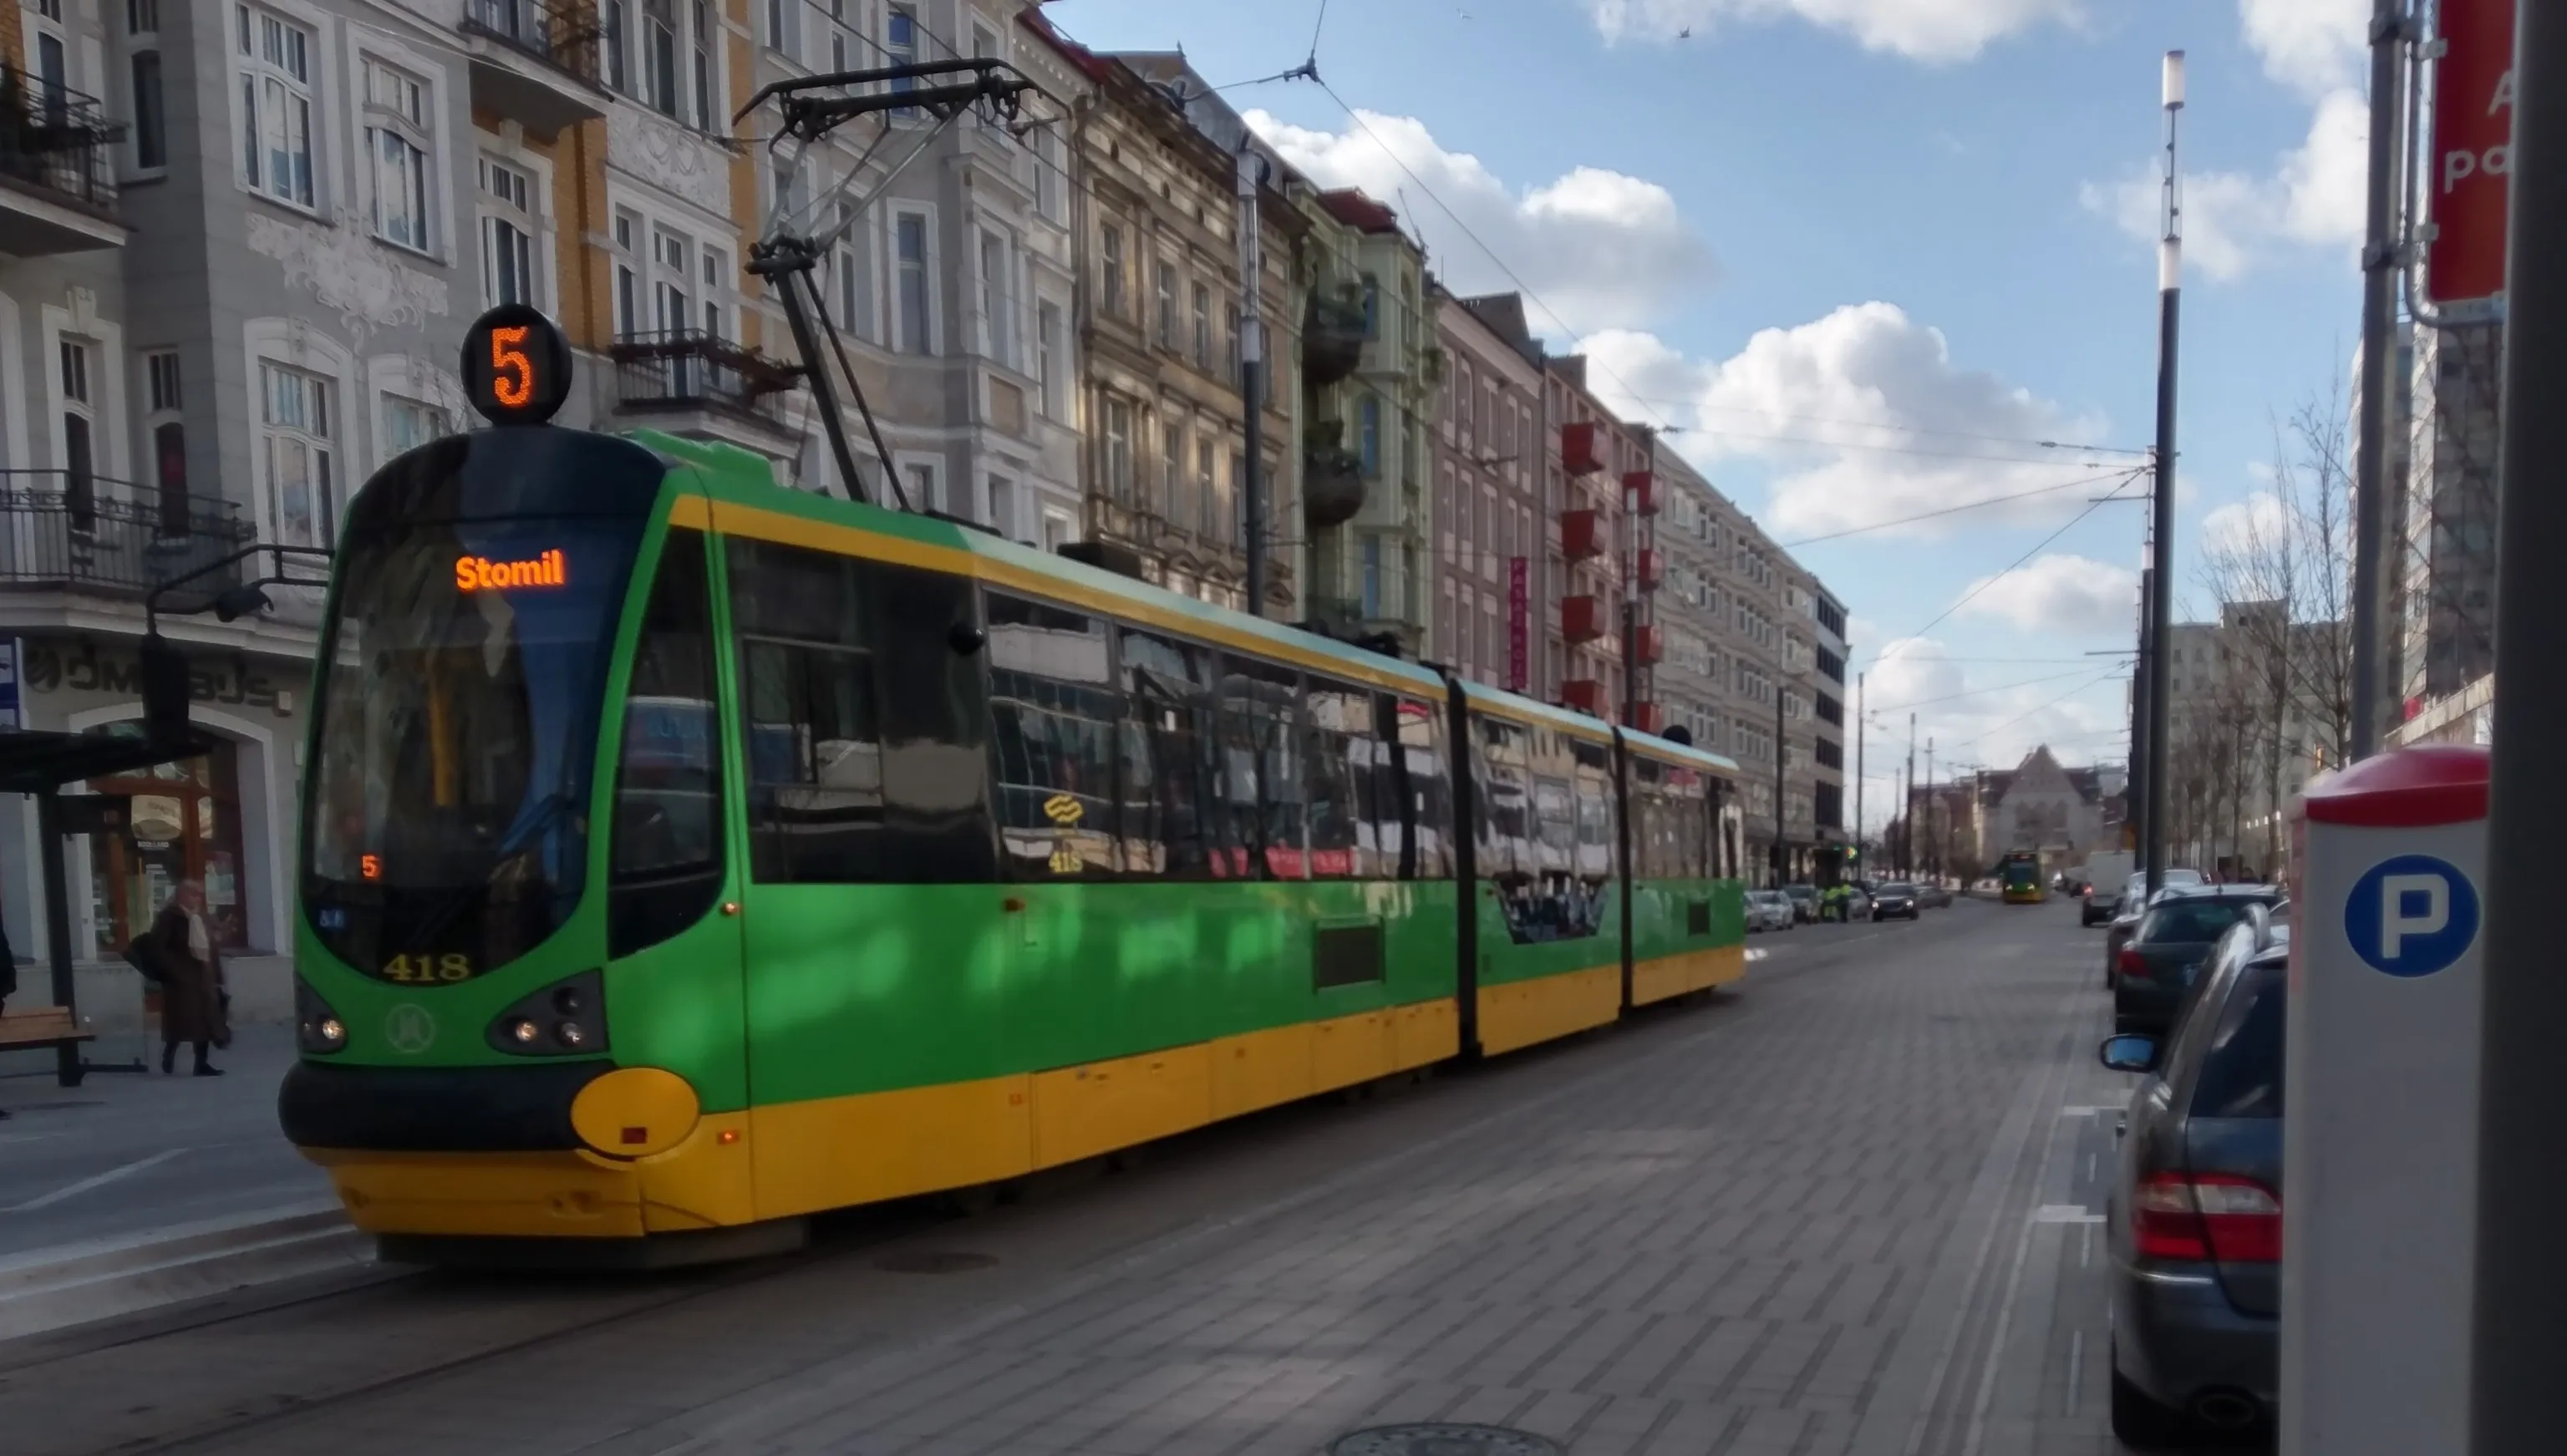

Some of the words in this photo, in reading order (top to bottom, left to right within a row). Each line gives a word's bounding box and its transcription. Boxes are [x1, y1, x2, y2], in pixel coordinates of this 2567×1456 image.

[492, 325, 531, 404] 5
[455, 549, 564, 591] Stomil
[67, 657, 279, 707] OMBUS
[361, 854, 383, 879] 5
[1049, 850, 1084, 873] 418
[2383, 874, 2450, 960] P
[383, 953, 470, 982] 418
